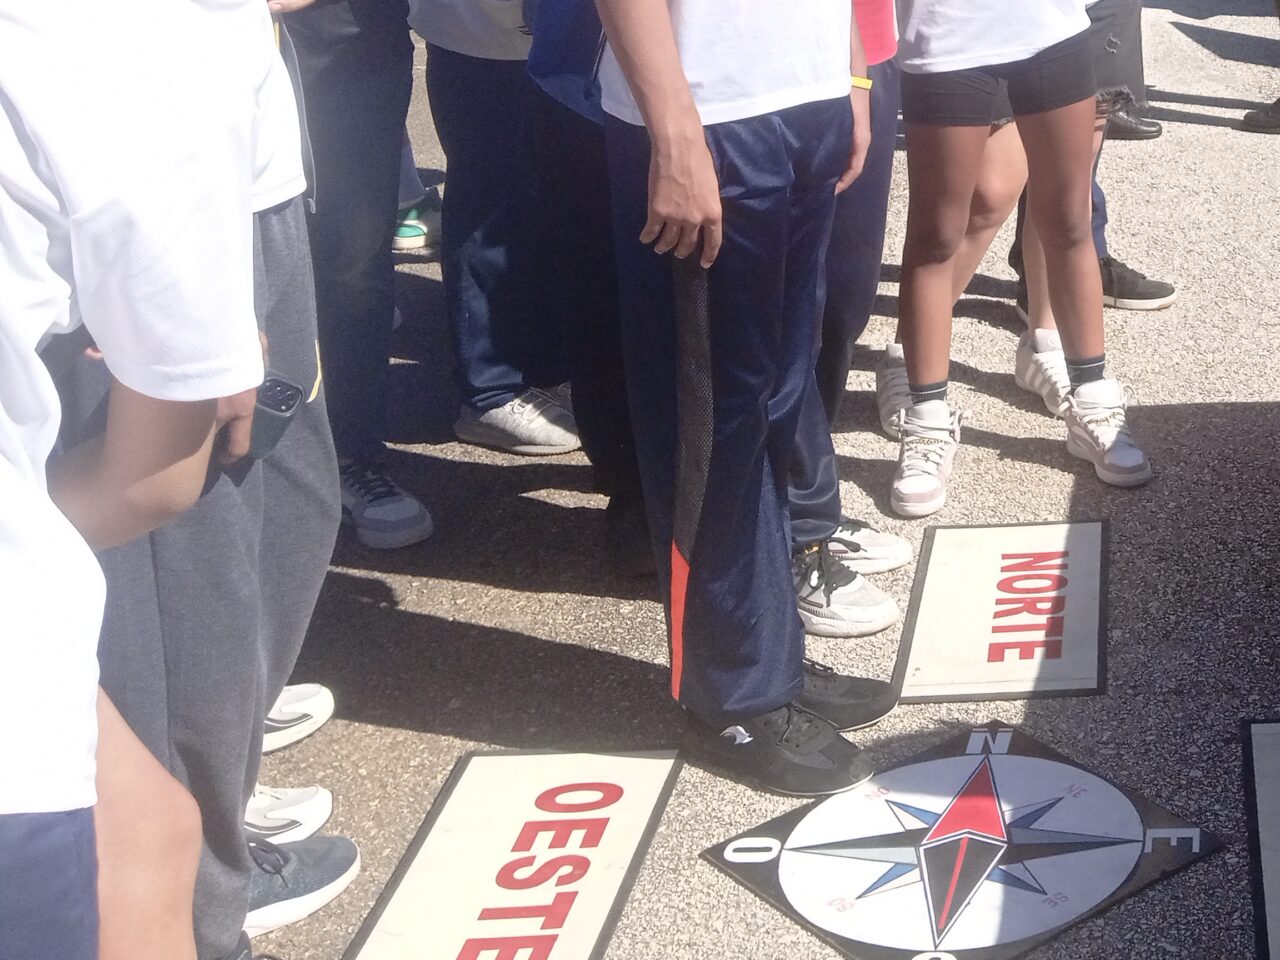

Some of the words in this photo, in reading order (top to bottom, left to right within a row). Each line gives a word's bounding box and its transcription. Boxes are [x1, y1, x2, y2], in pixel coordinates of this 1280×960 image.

[987, 551, 1069, 663] NORTE
[966, 728, 1013, 754] N
[1064, 784, 1087, 798] NE
[723, 837, 782, 863] O
[1144, 828, 1201, 853] E
[456, 782, 624, 960] OESTE
